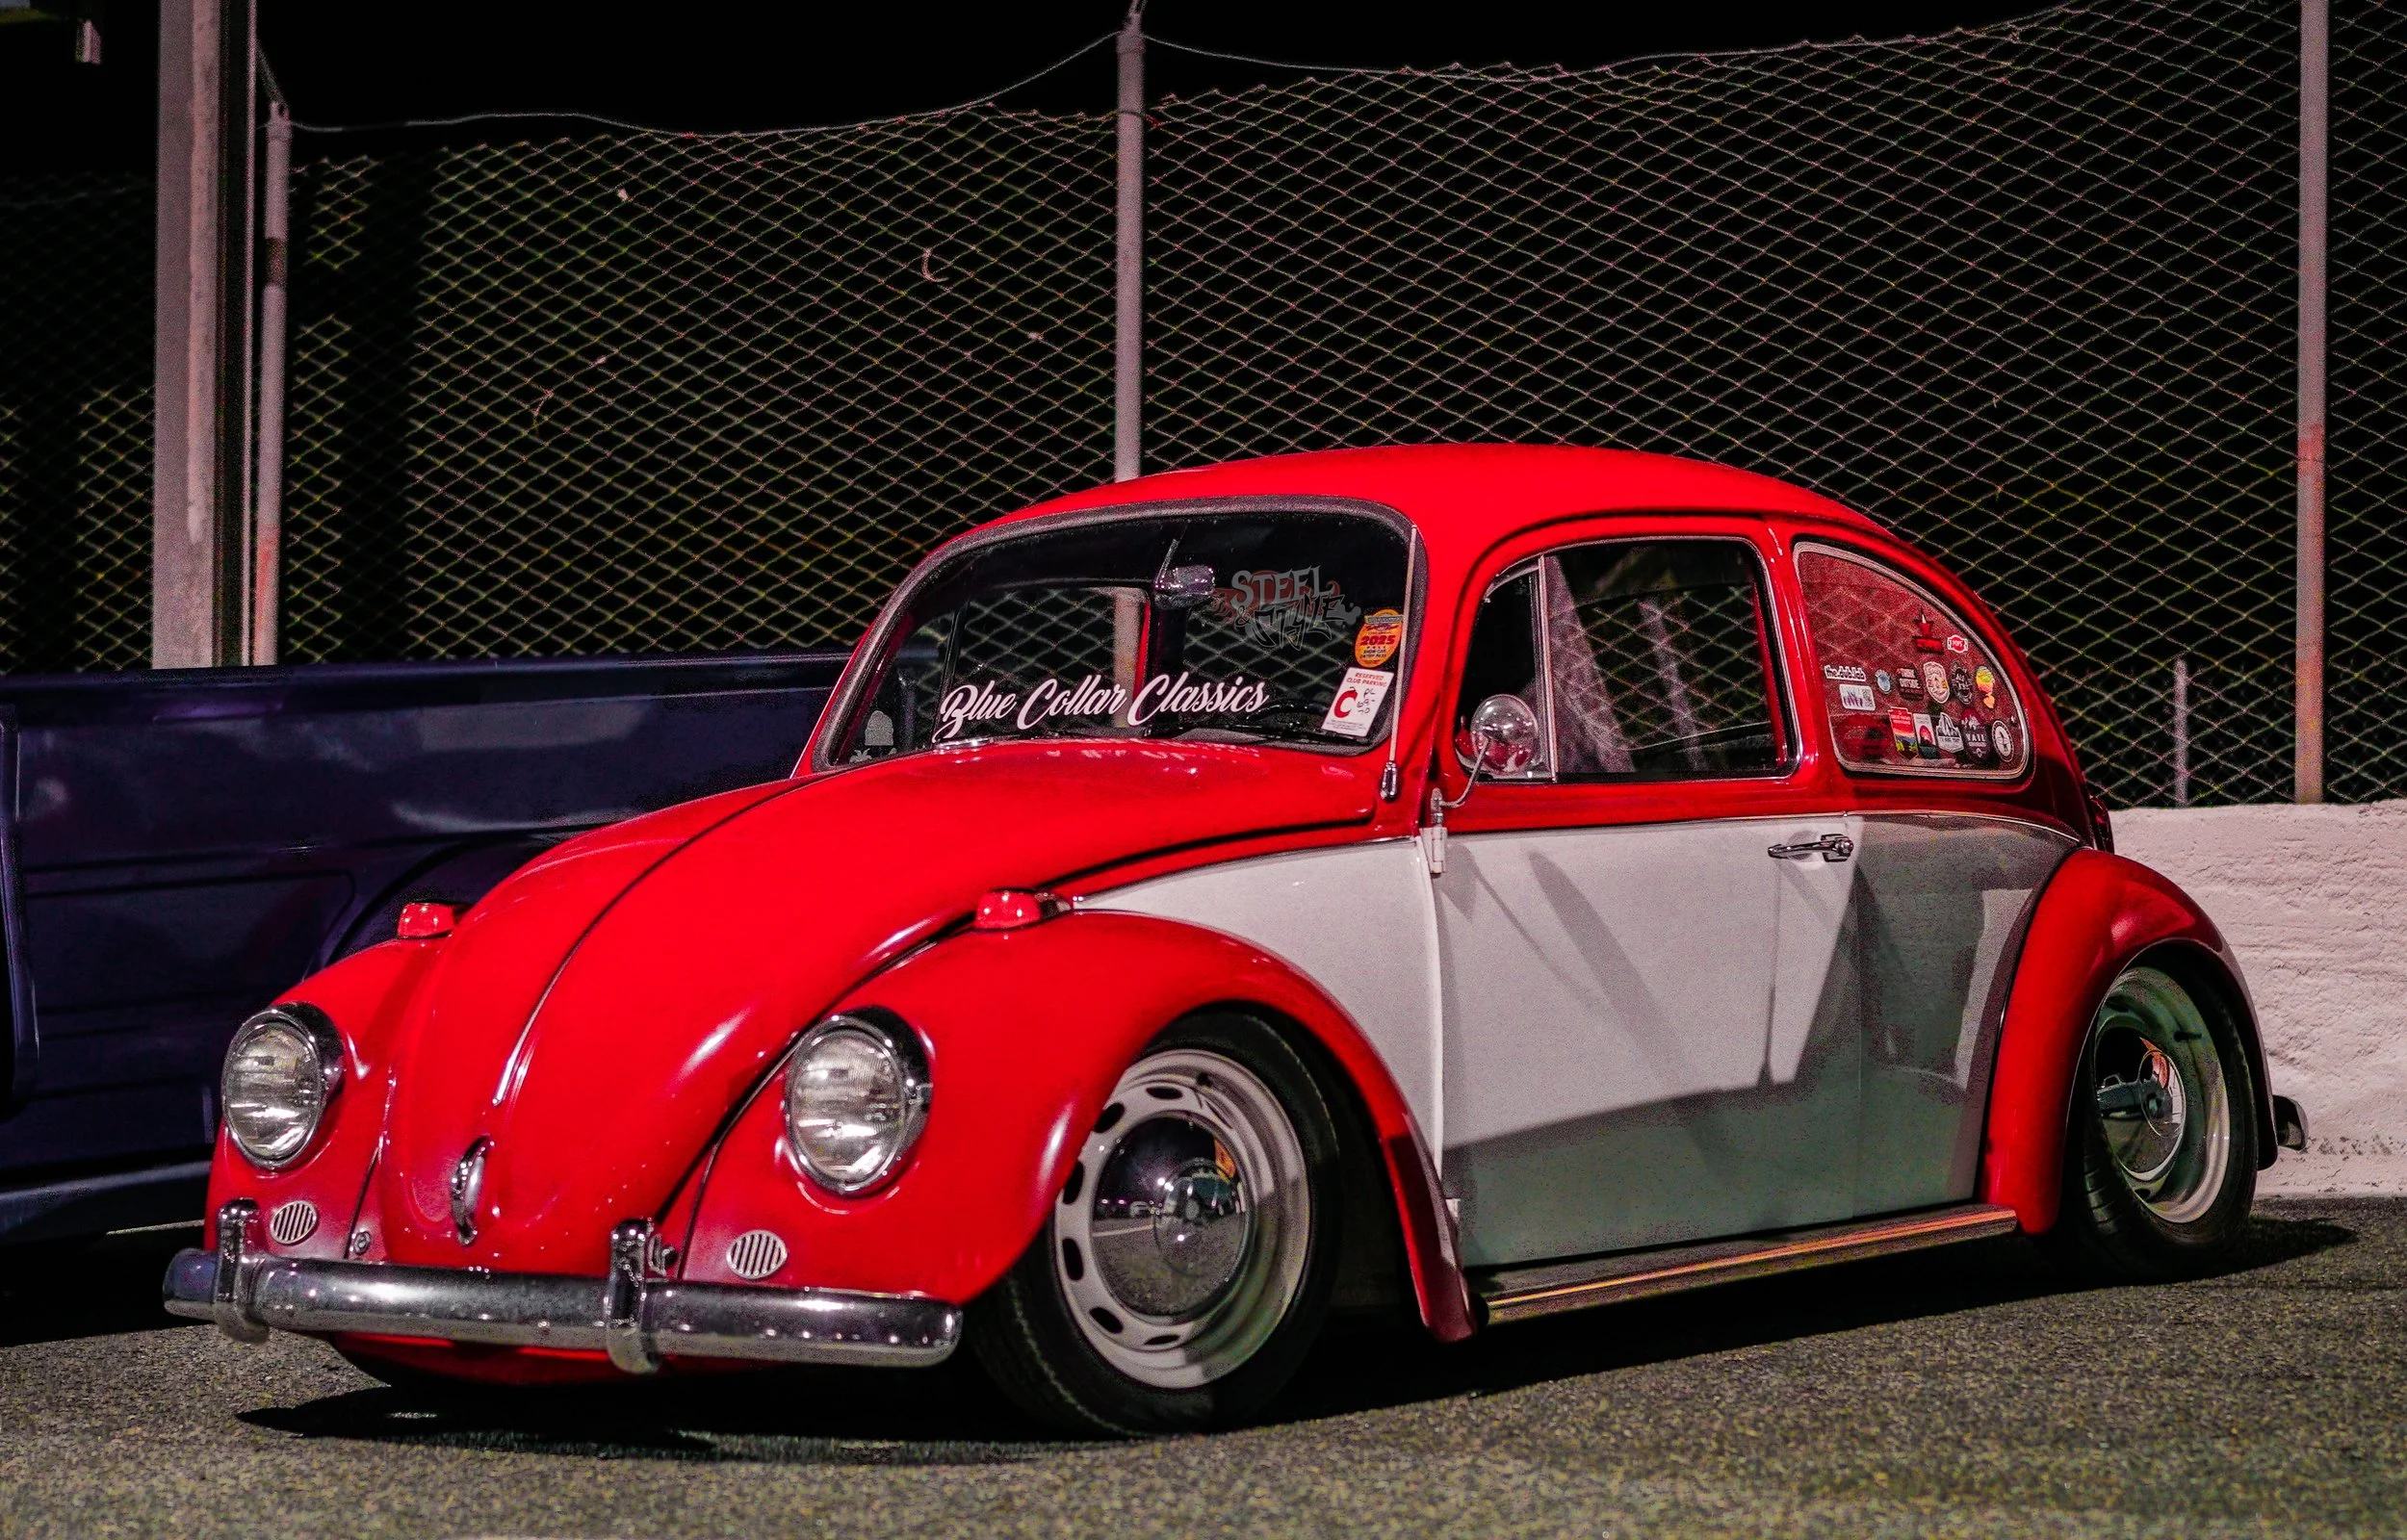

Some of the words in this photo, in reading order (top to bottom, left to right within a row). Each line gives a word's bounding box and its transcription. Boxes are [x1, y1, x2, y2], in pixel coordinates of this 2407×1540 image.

[1230, 565, 1335, 610] STEEL
[1234, 605, 1252, 627] &
[1252, 593, 1346, 652] STYLE
[1360, 634, 1397, 646] 2025
[1355, 672, 1385, 680] RESERVED
[1361, 679, 1387, 687] PARKING
[932, 680, 1018, 744] Blue
[1017, 674, 1127, 731] Collar
[1126, 671, 1271, 727] Classics
[1333, 689, 1359, 719] C
